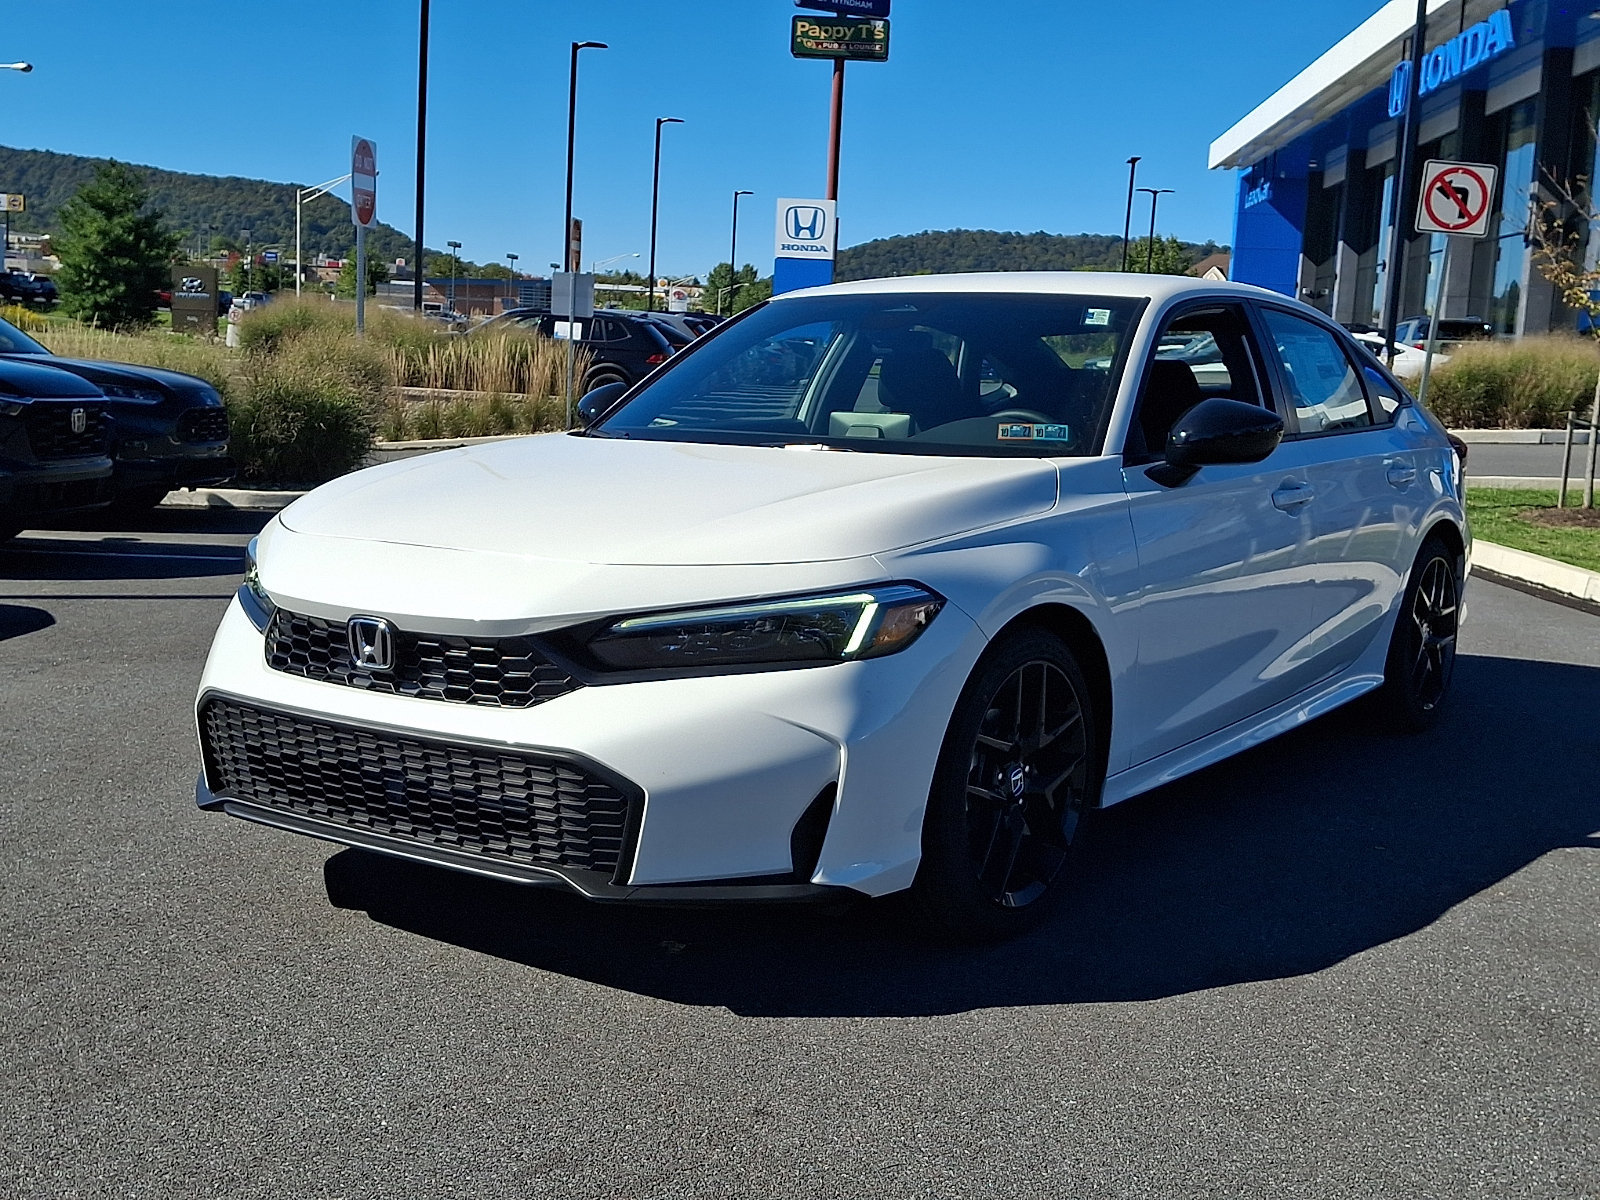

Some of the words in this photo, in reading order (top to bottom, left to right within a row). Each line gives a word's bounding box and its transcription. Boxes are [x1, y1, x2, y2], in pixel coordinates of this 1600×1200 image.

[795, 21, 855, 40] Pappy
[857, 24, 885, 39] T's
[849, 43, 882, 51] LOUNGE
[781, 244, 828, 252] HONDA
